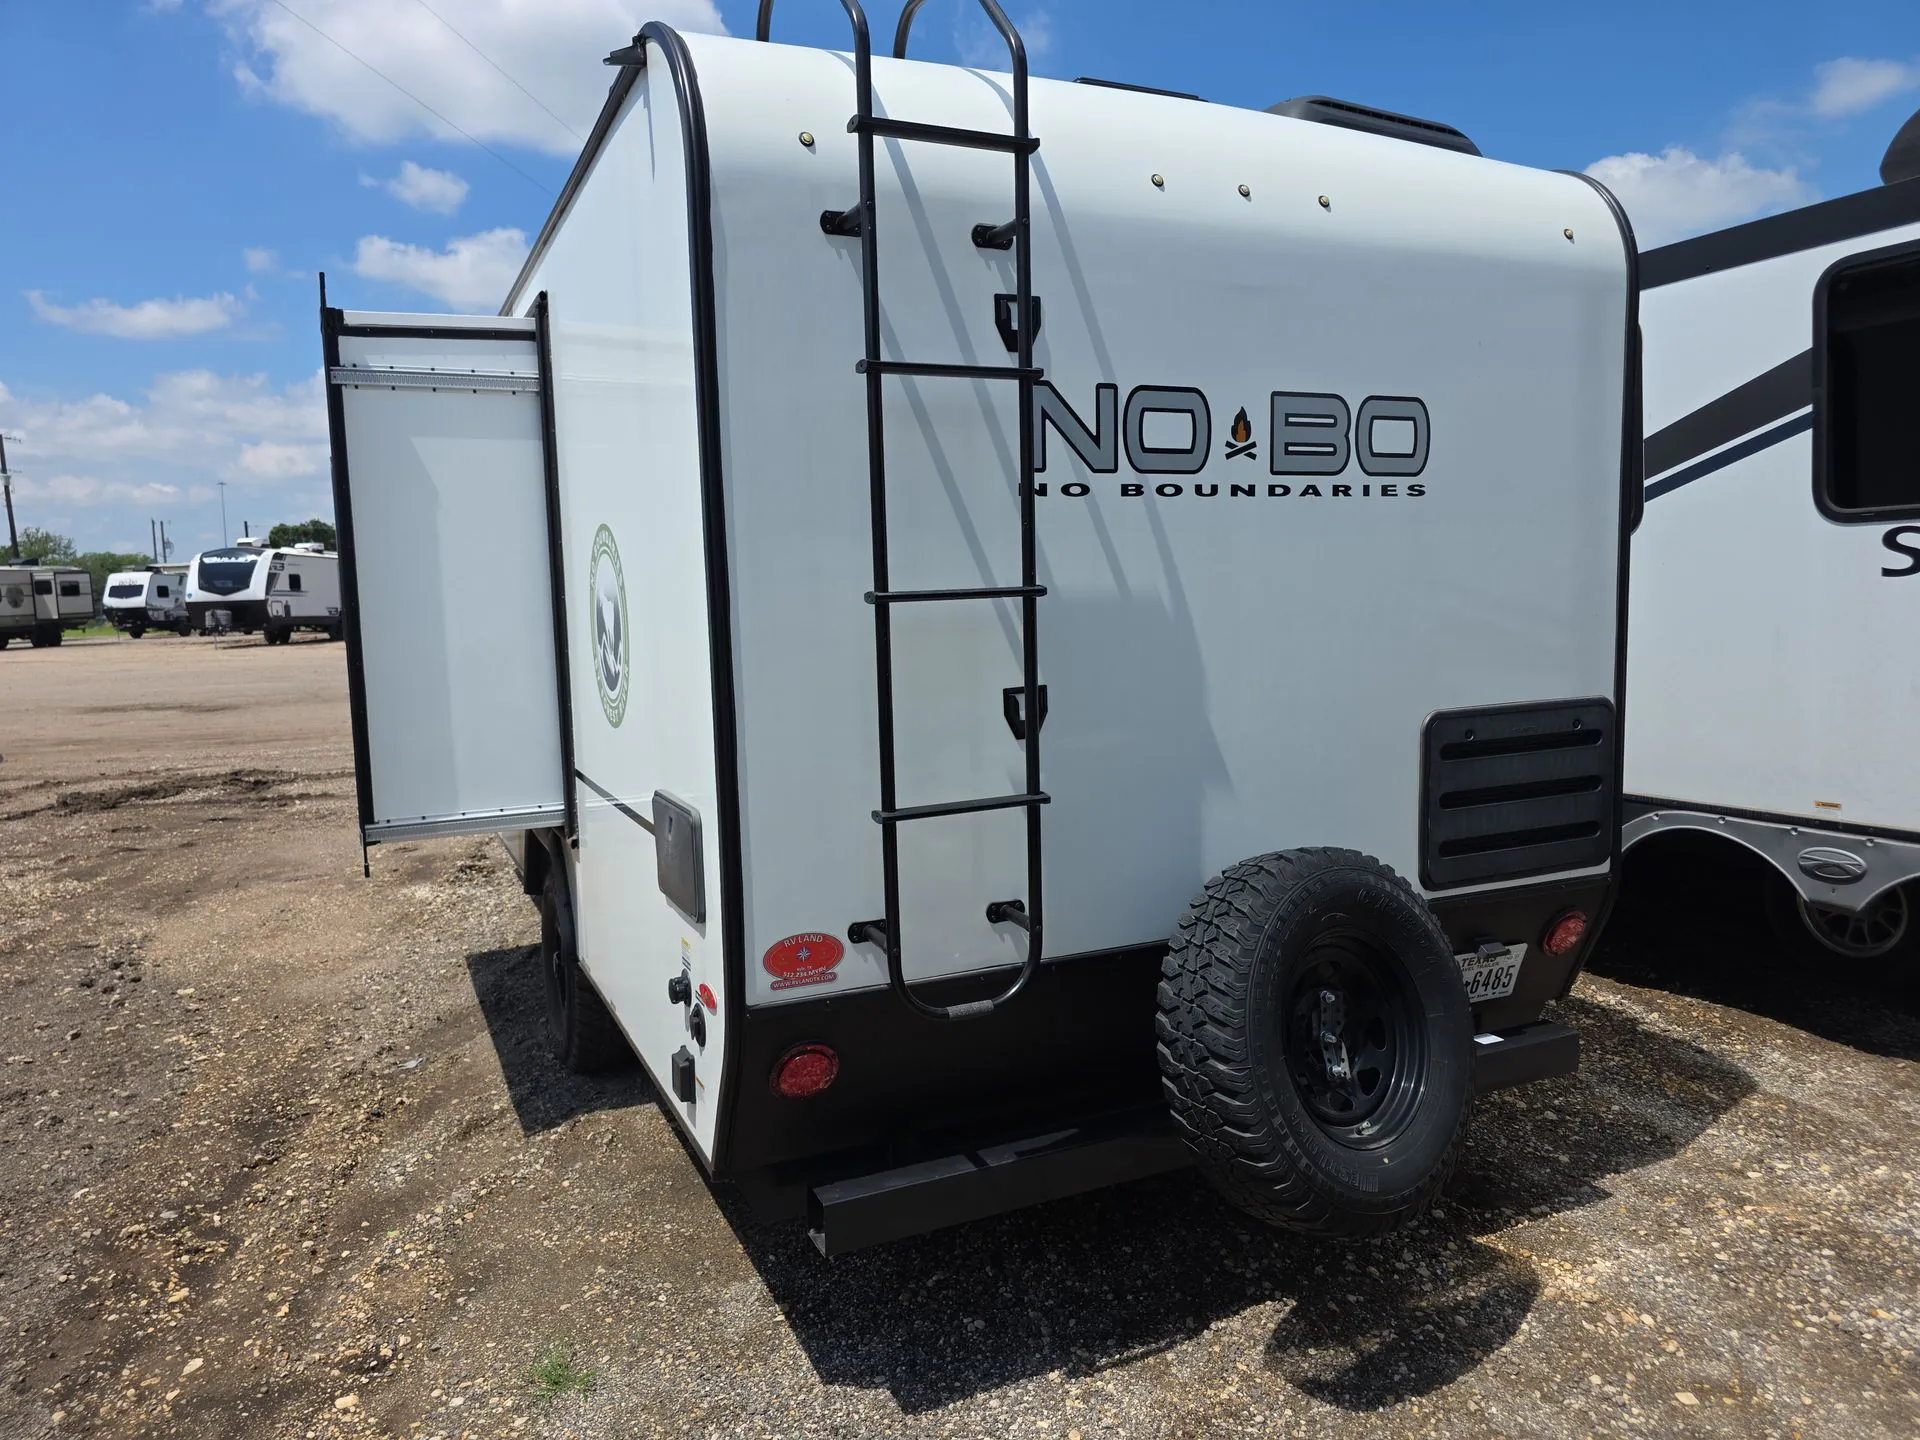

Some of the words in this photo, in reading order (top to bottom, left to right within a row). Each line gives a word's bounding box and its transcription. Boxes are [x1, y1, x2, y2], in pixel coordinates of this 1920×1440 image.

[1033, 380, 1212, 475] NO
[1269, 390, 1431, 477] BO
[1120, 482, 1427, 498] BOUNDARIES
[783, 936, 796, 948] RV
[798, 934, 823, 943] LAND
[1469, 964, 1516, 994] 6485
